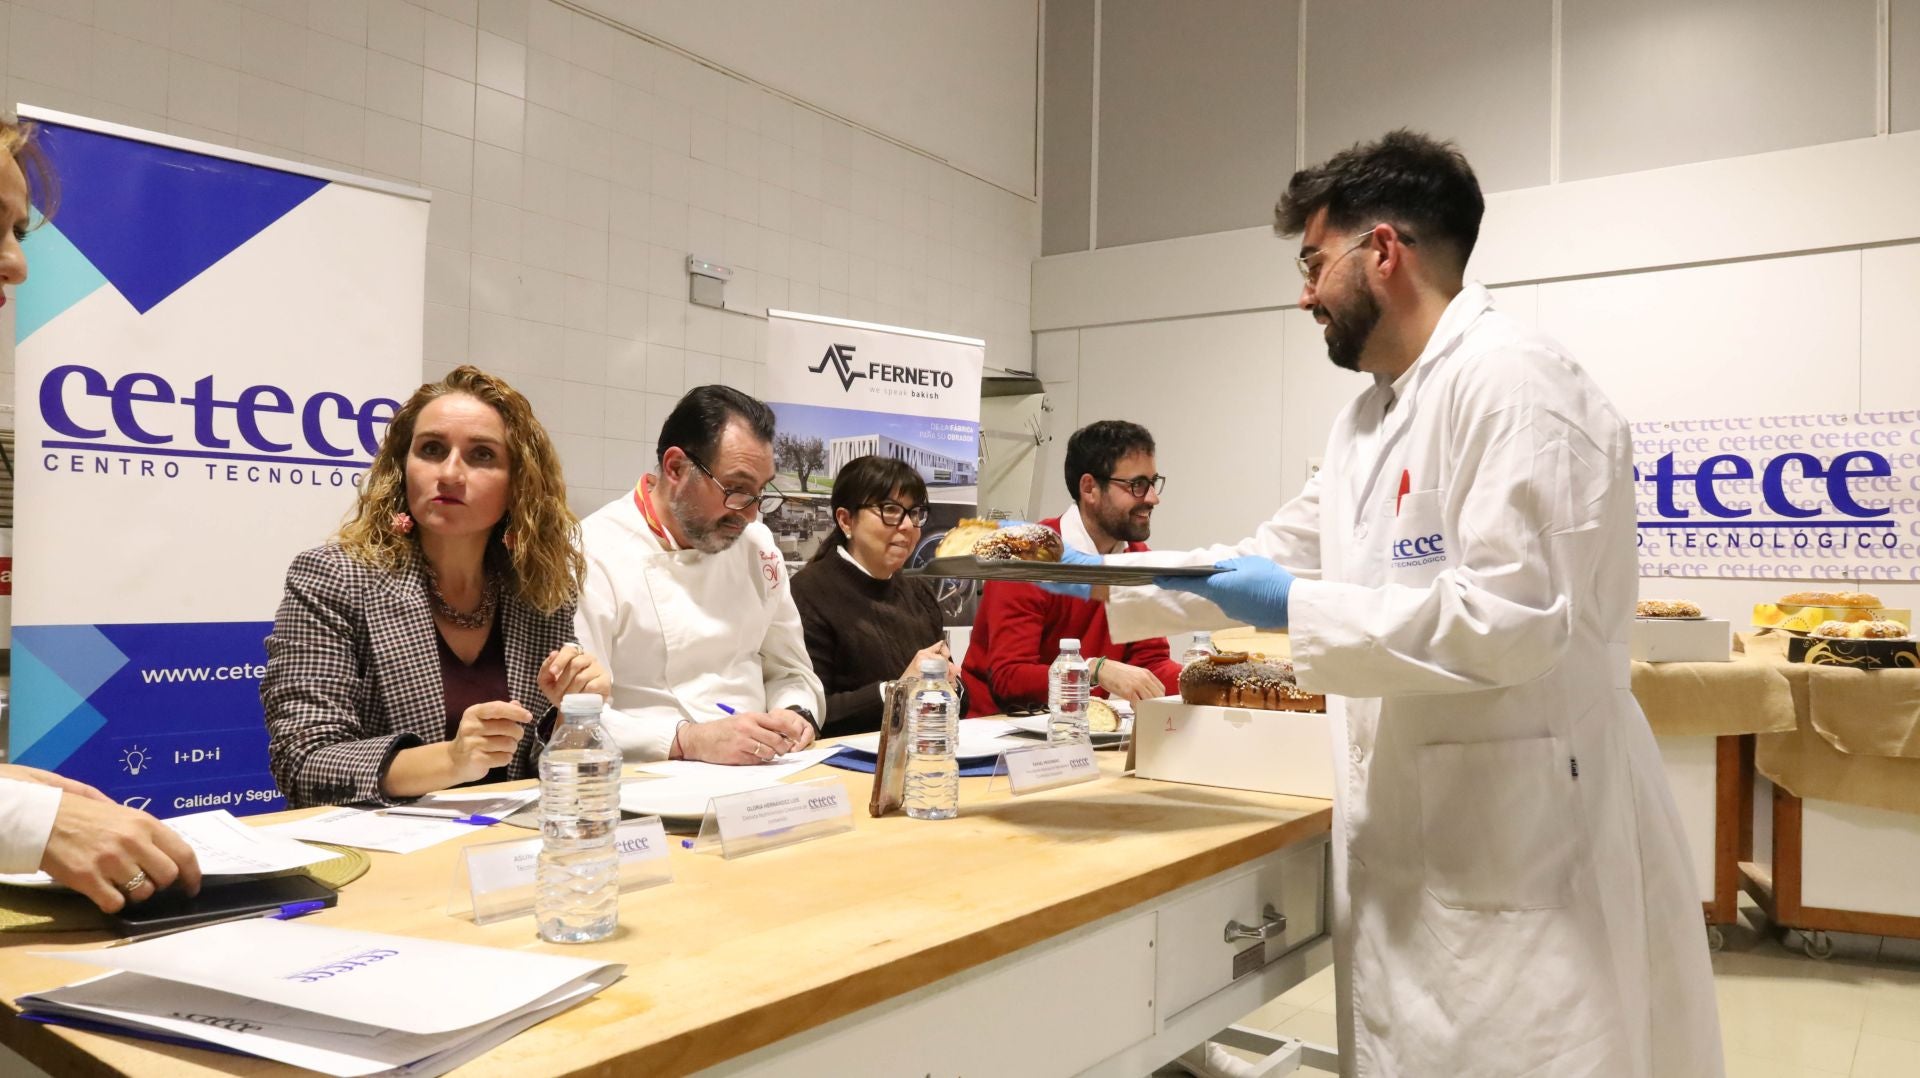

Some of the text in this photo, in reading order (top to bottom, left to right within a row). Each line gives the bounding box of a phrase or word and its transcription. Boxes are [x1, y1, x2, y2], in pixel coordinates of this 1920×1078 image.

[869, 362, 953, 388] FERNETO
[911, 390, 939, 399] bakish
[39, 364, 403, 458] cetece
[44, 453, 179, 478] CENTRO
[1634, 451, 1892, 518] tece
[1393, 533, 1444, 557] tece
[1666, 530, 1898, 549] TECNOLÓGICO
[141, 663, 267, 684] www.cete
[1164, 716, 1177, 732] 1
[174, 747, 221, 764] I+D+i
[174, 789, 285, 809] Calidad y Segu
[614, 836, 649, 854] etece
